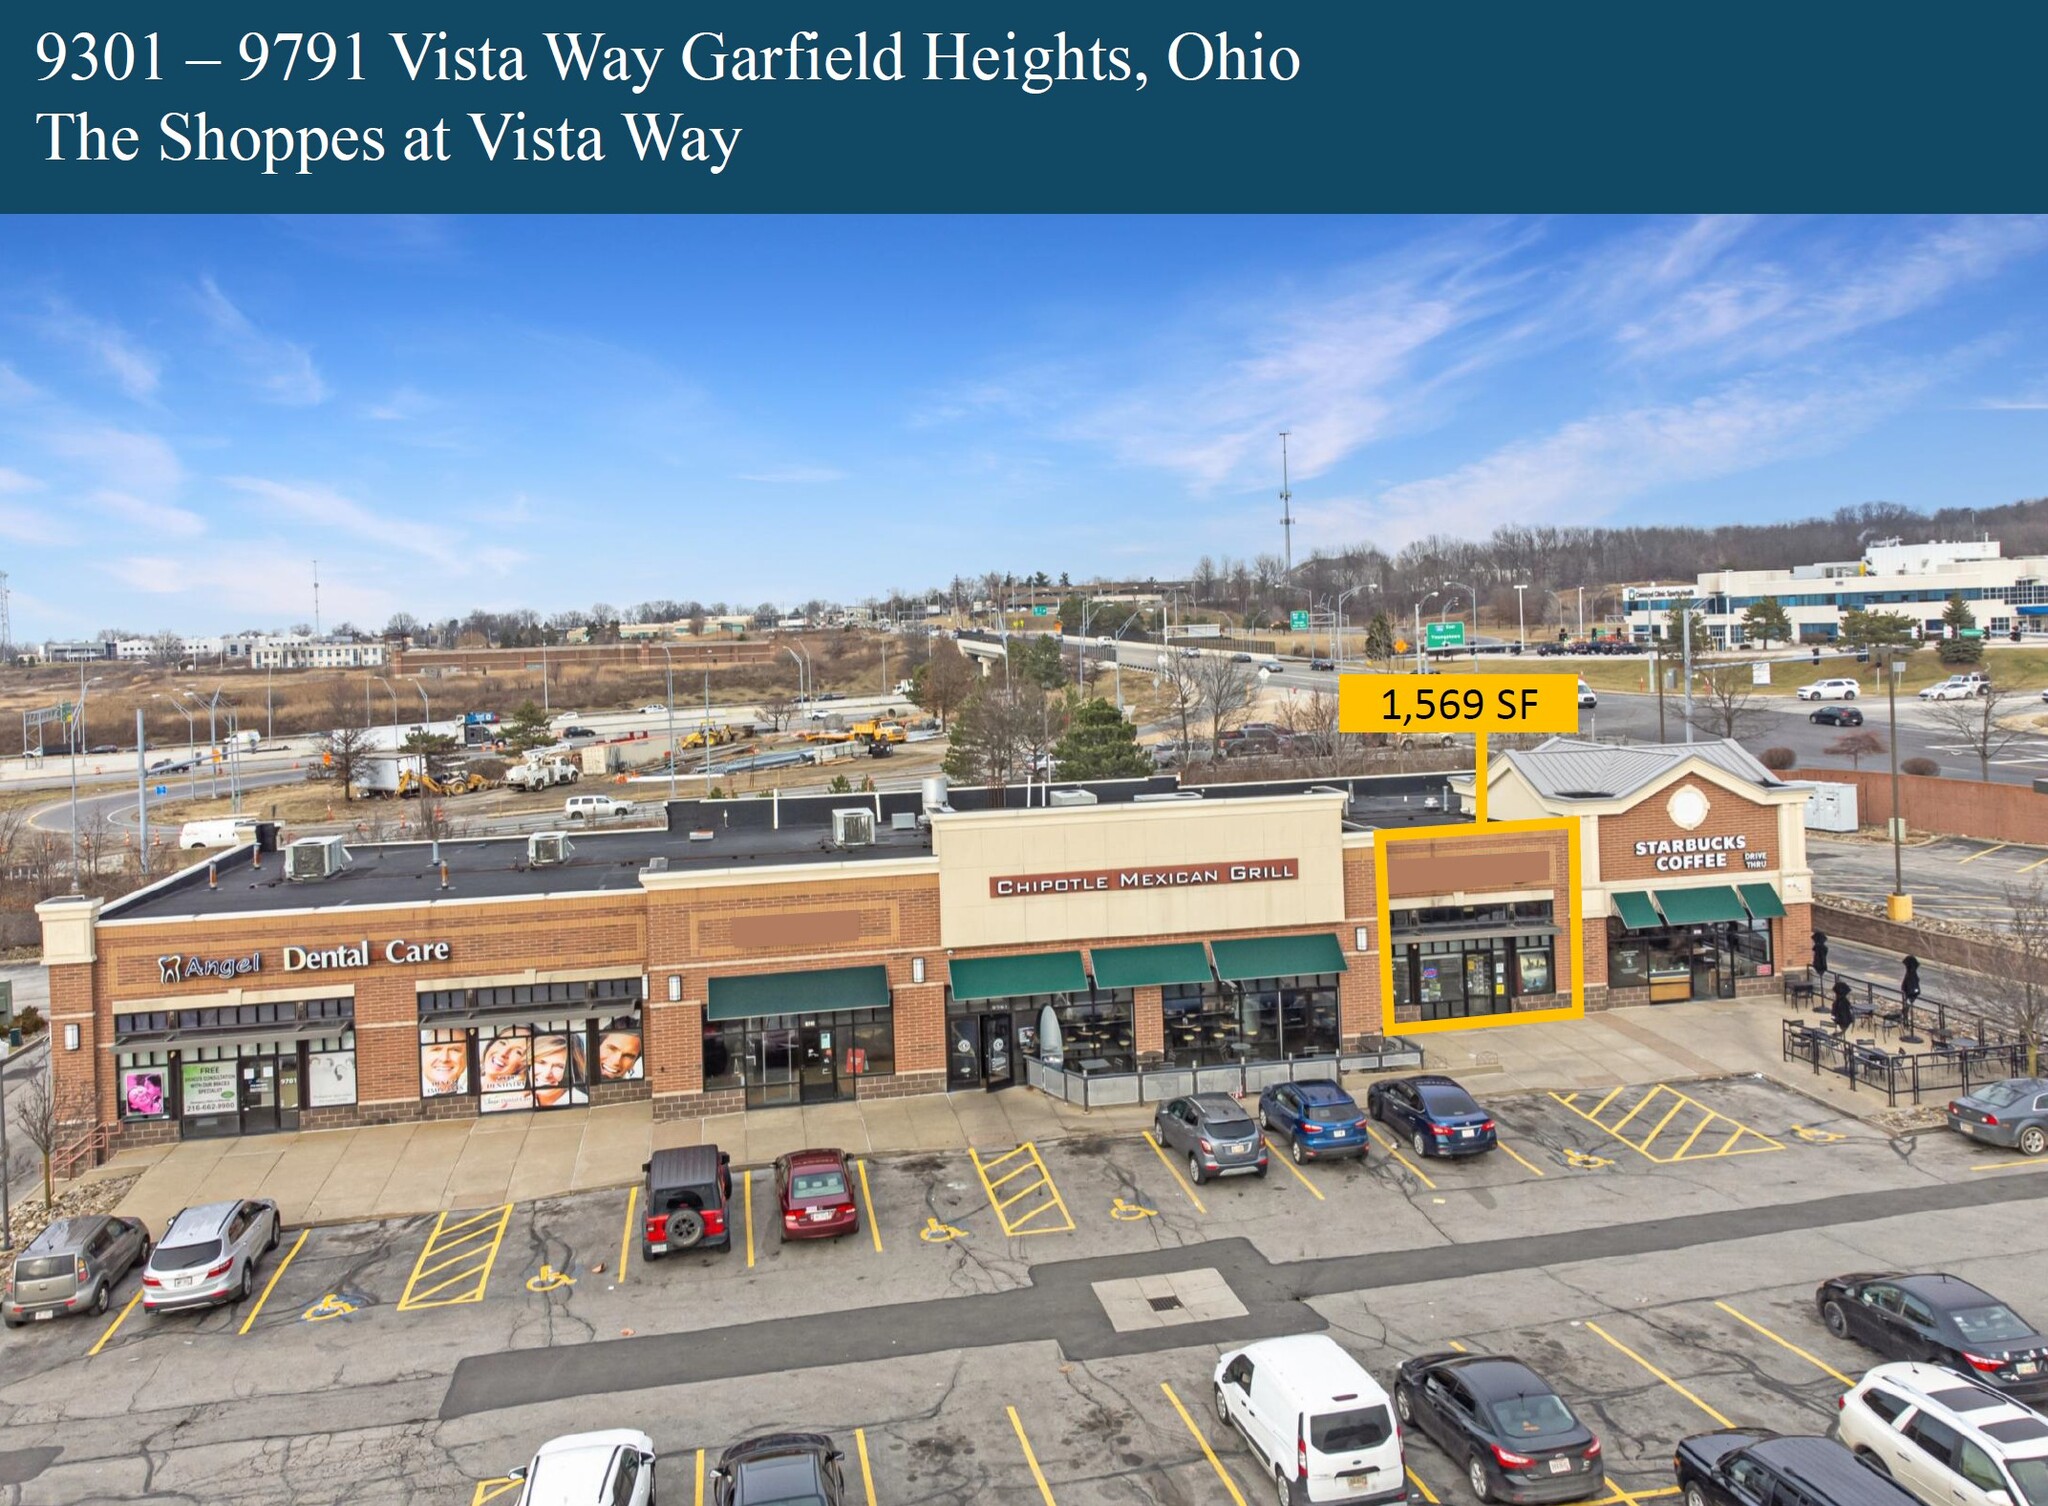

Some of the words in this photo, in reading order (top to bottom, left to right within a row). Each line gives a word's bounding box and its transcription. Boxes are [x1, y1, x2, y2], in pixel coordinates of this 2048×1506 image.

[1635, 835, 1746, 856] STARBUCKS
[1656, 853, 1727, 871] COFFEE
[1744, 852, 1767, 860] DRIVE
[1746, 860, 1767, 869] THRU
[997, 876, 1108, 894] CHIPOTLE
[1120, 869, 1218, 887] MEXICAN
[1230, 865, 1294, 881] GRILL
[185, 952, 260, 979] Angel
[283, 940, 369, 972] Dental
[385, 939, 449, 964] Care
